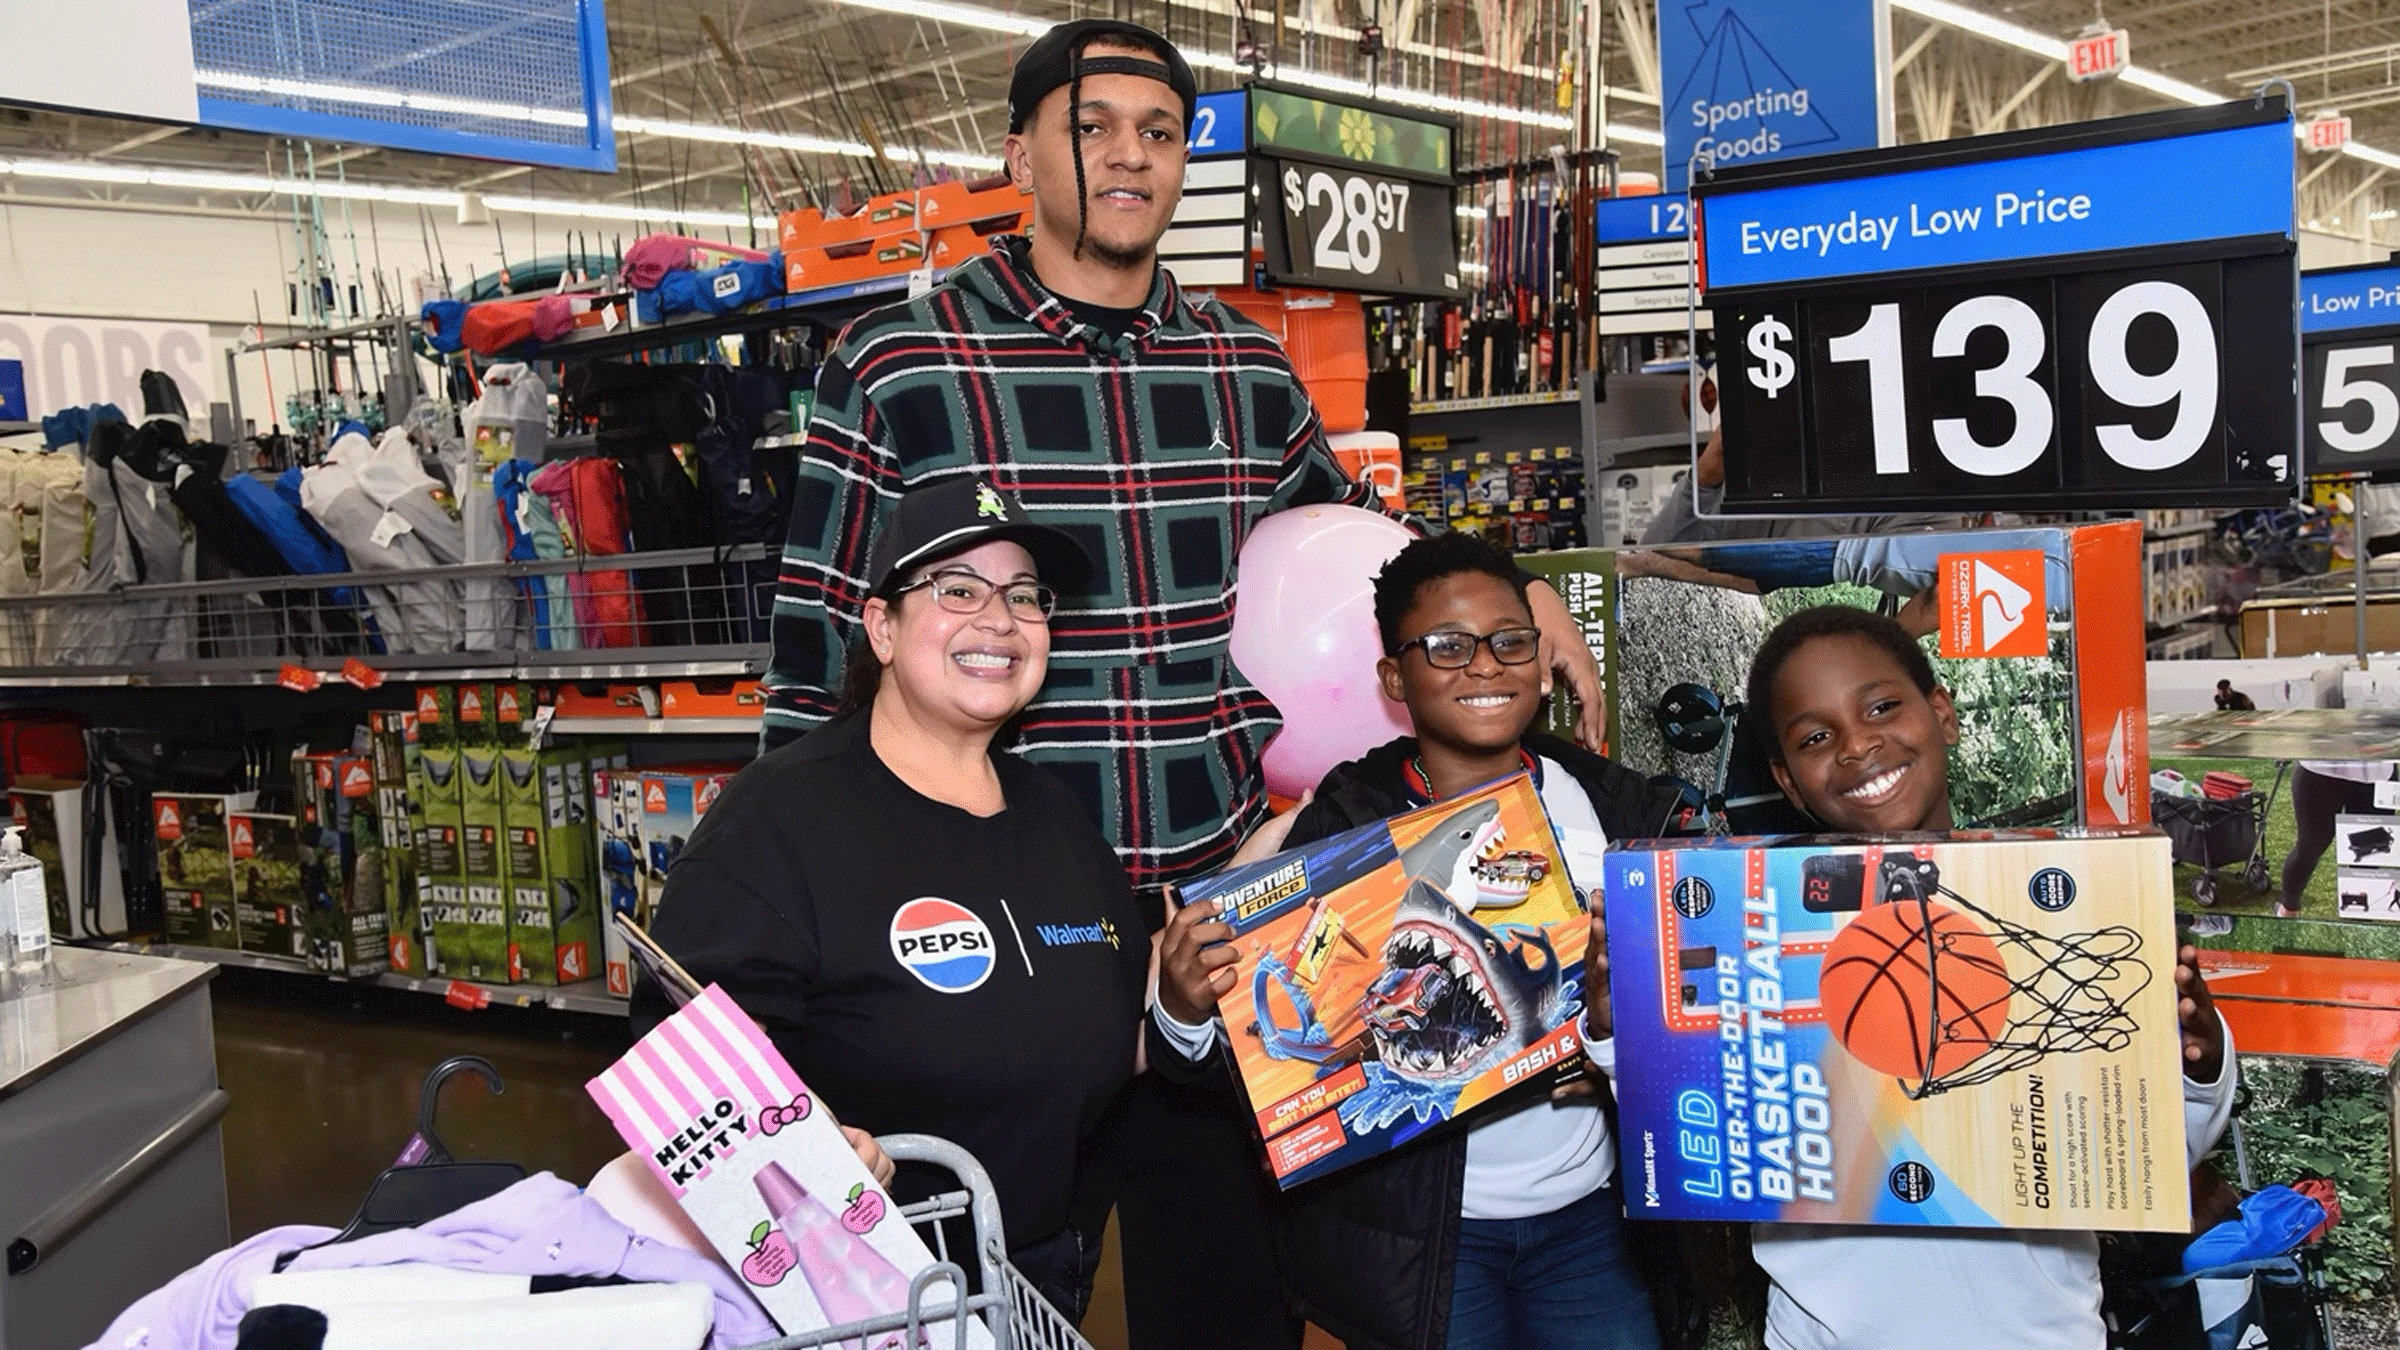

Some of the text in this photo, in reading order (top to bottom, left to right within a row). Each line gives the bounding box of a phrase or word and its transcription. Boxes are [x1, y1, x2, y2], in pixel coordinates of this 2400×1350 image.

[2074, 36, 2116, 76] EXIT
[1692, 87, 1808, 132] Sporting
[1694, 127, 1781, 169] Goods
[2313, 121, 2345, 147] EXIT
[1741, 189, 2092, 257] Everyday Low Price
[2312, 293, 2360, 314] Low
[1246, 880, 1300, 915] FORCE
[1808, 879, 1829, 902] 22
[2040, 877, 2048, 903] AUTO
[2047, 873, 2057, 906] SCORE
[899, 931, 989, 957] PEPSI
[1037, 922, 1106, 947] Walmart
[1502, 1042, 1557, 1084] BASH
[1560, 1034, 1578, 1054] &
[1745, 887, 1793, 1199] BASKETBALL
[1717, 955, 1752, 1200] OVER-THE-DOOR
[2112, 1064, 2121, 1080] rim
[1275, 1085, 1325, 1118] CAN YOU
[2064, 1091, 2072, 1111] with
[2113, 1082, 2126, 1148] spring-loaded
[656, 1100, 733, 1167] HELLO
[671, 1114, 747, 1186] KITTY
[1678, 1088, 1723, 1198] LED
[1793, 1064, 1834, 1200] HOOP
[2028, 1074, 2049, 1209] COMPETITION!
[2066, 1139, 2077, 1159] high
[2077, 1096, 2091, 1209] sensor-activated scoring
[2100, 1067, 2116, 1210] Play hard with shatter-resistant
[2137, 1078, 2153, 1210] Easily hangs from most doors
[2010, 1103, 2028, 1207] LIGHT UP THE
[2068, 1169, 2076, 1182] for
[1897, 1172, 1907, 1191] 60
[1908, 1163, 1917, 1201] SECOND
[2069, 1183, 2078, 1208] Shoot
[2118, 1158, 2128, 1210] scoreboard
